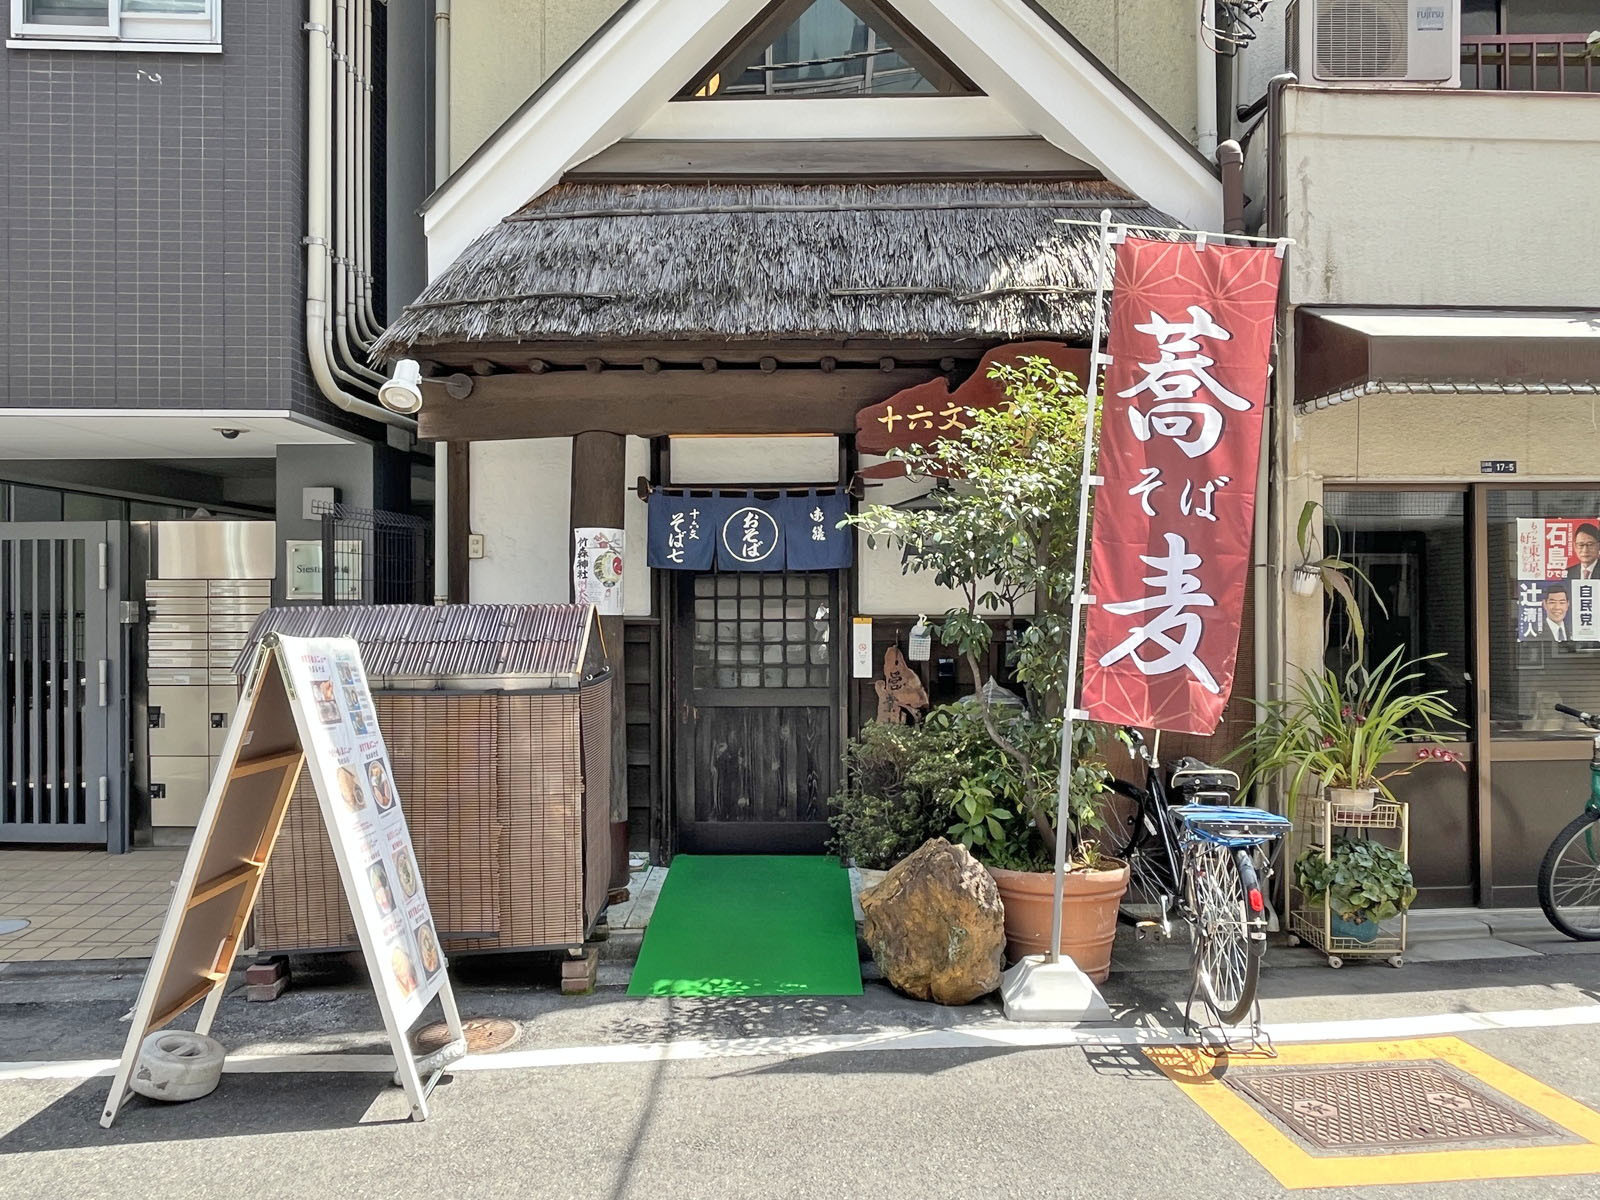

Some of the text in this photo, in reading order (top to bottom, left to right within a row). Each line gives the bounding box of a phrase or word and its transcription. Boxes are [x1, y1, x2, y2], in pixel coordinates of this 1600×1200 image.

[877, 401, 967, 434] 十六文
[1496, 463, 1515, 472] 17-5
[1128, 466, 1231, 522] そば
[666, 512, 687, 564] そば七
[688, 508, 701, 540] 十六文
[742, 511, 764, 558] おそば
[1099, 533, 1221, 694] 麦
[1579, 584, 1593, 627] 自民党
